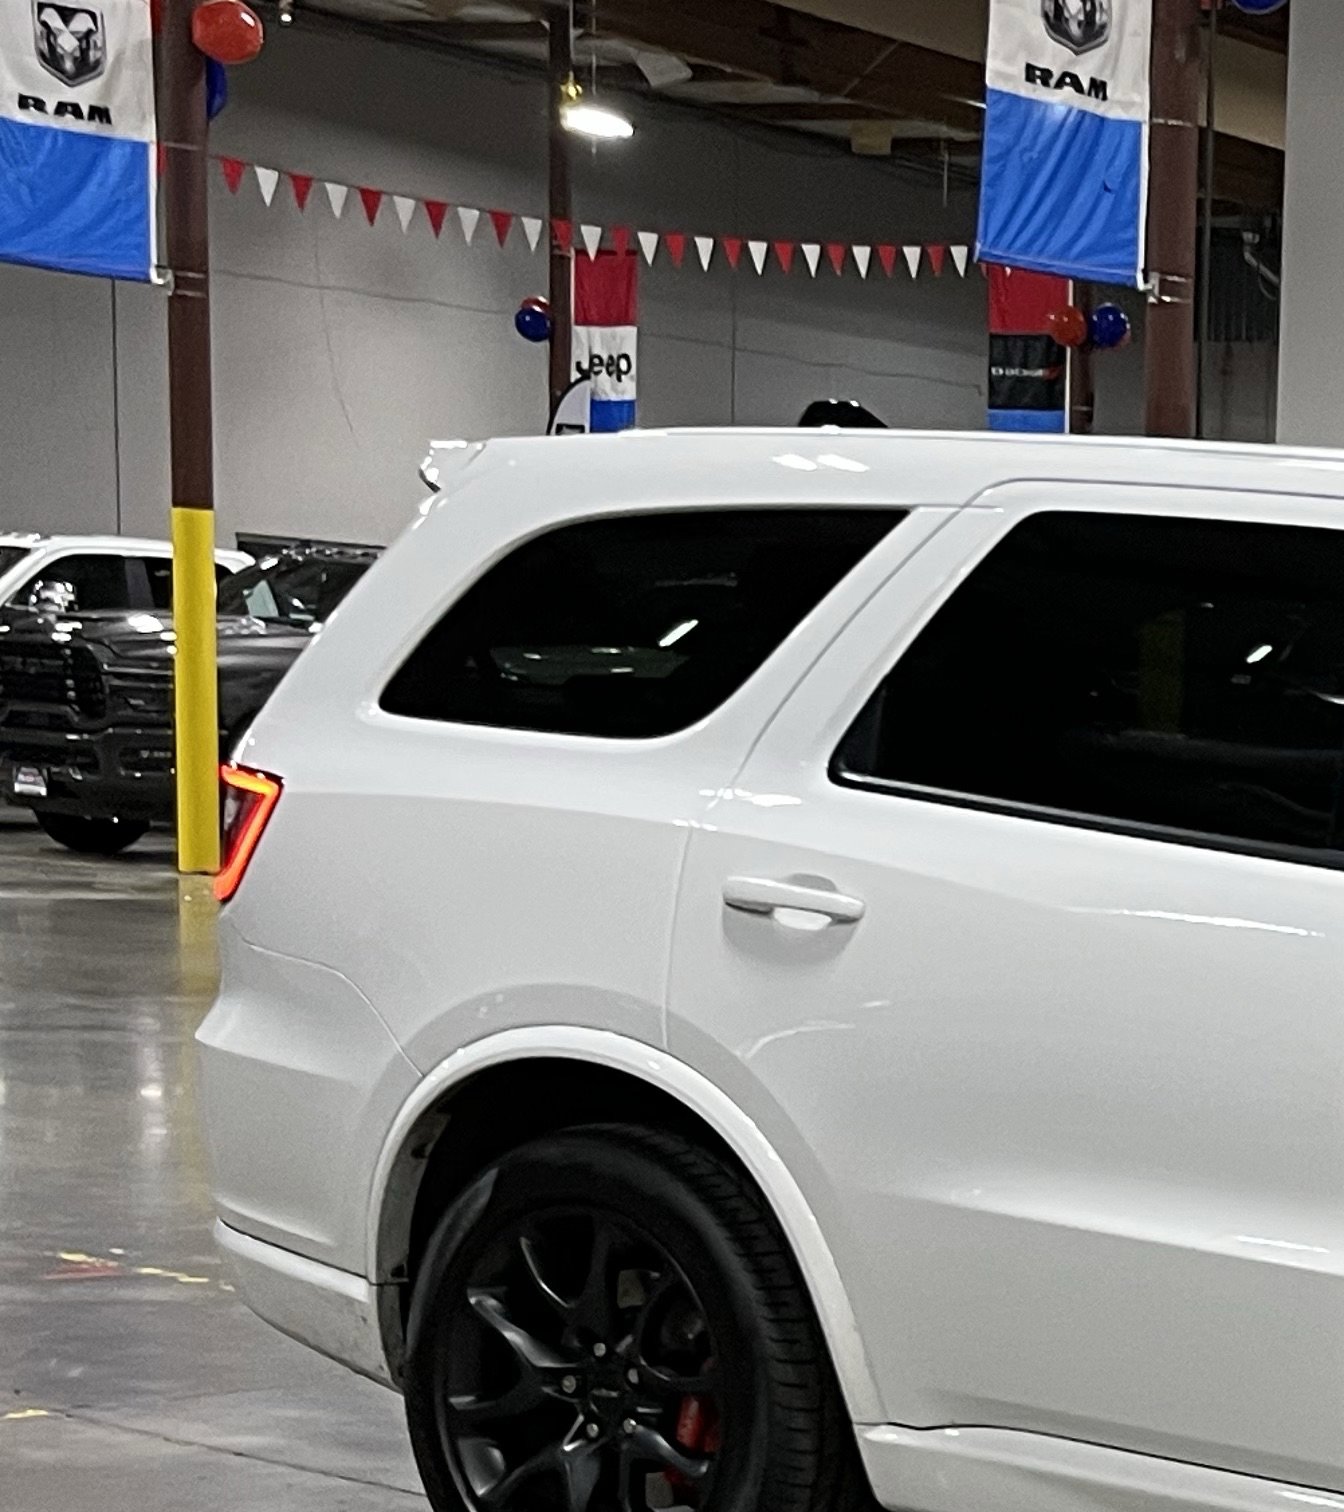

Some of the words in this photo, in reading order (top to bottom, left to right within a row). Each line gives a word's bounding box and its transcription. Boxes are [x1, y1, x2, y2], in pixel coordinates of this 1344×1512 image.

[1024, 62, 1108, 102] RAM
[17, 92, 113, 126] RAM
[575, 352, 632, 383] Jeep
